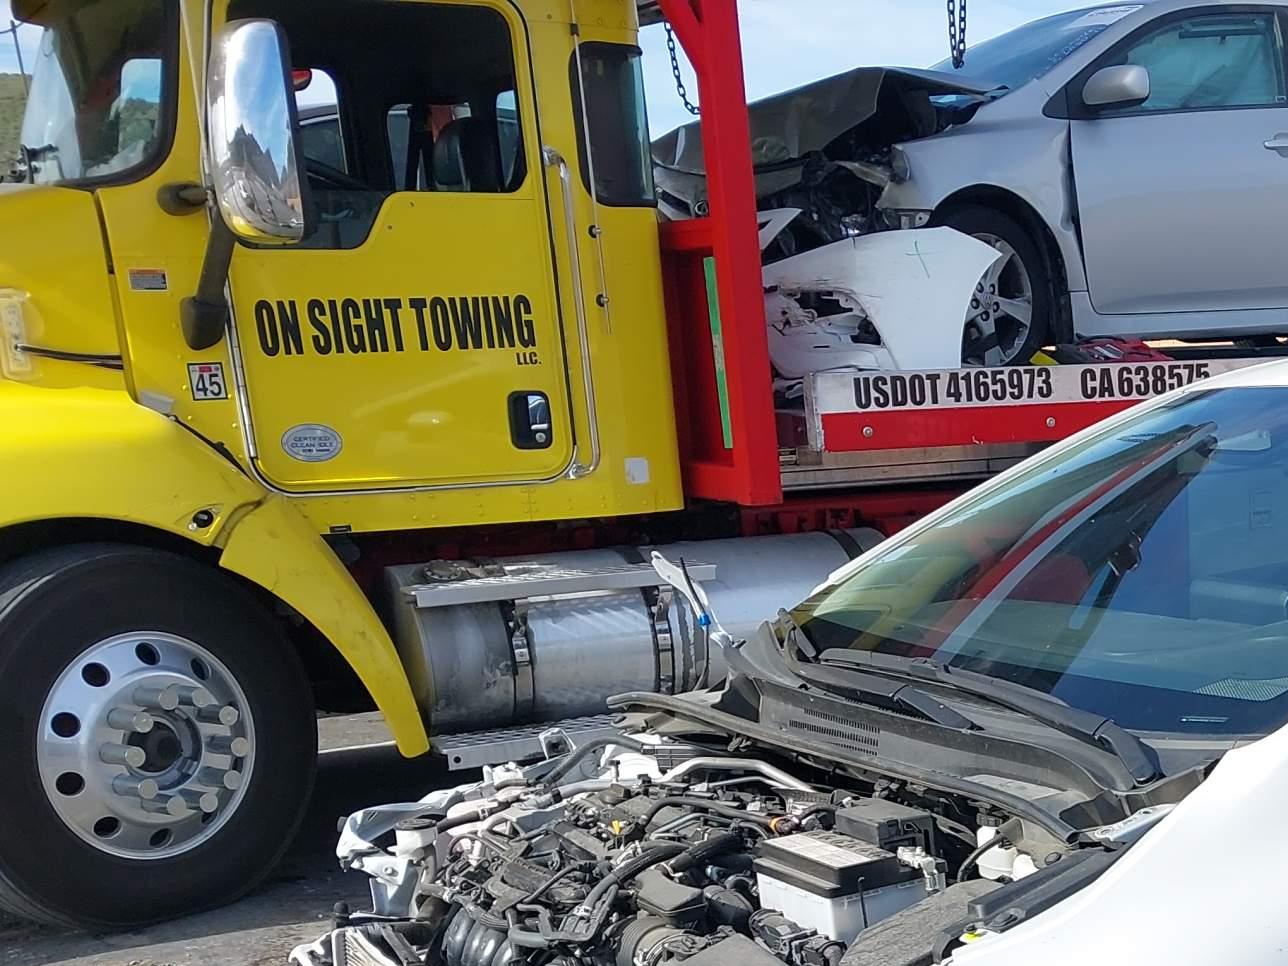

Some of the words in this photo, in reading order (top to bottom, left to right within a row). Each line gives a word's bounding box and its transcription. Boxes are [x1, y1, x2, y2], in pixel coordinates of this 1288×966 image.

[254, 299, 304, 357] ON
[306, 298, 404, 355] SIGHT
[408, 294, 537, 352] TOWING
[515, 351, 543, 366] LLC.
[195, 373, 223, 397] 45
[853, 373, 940, 410] USDOT
[946, 367, 1052, 403] 4165973
